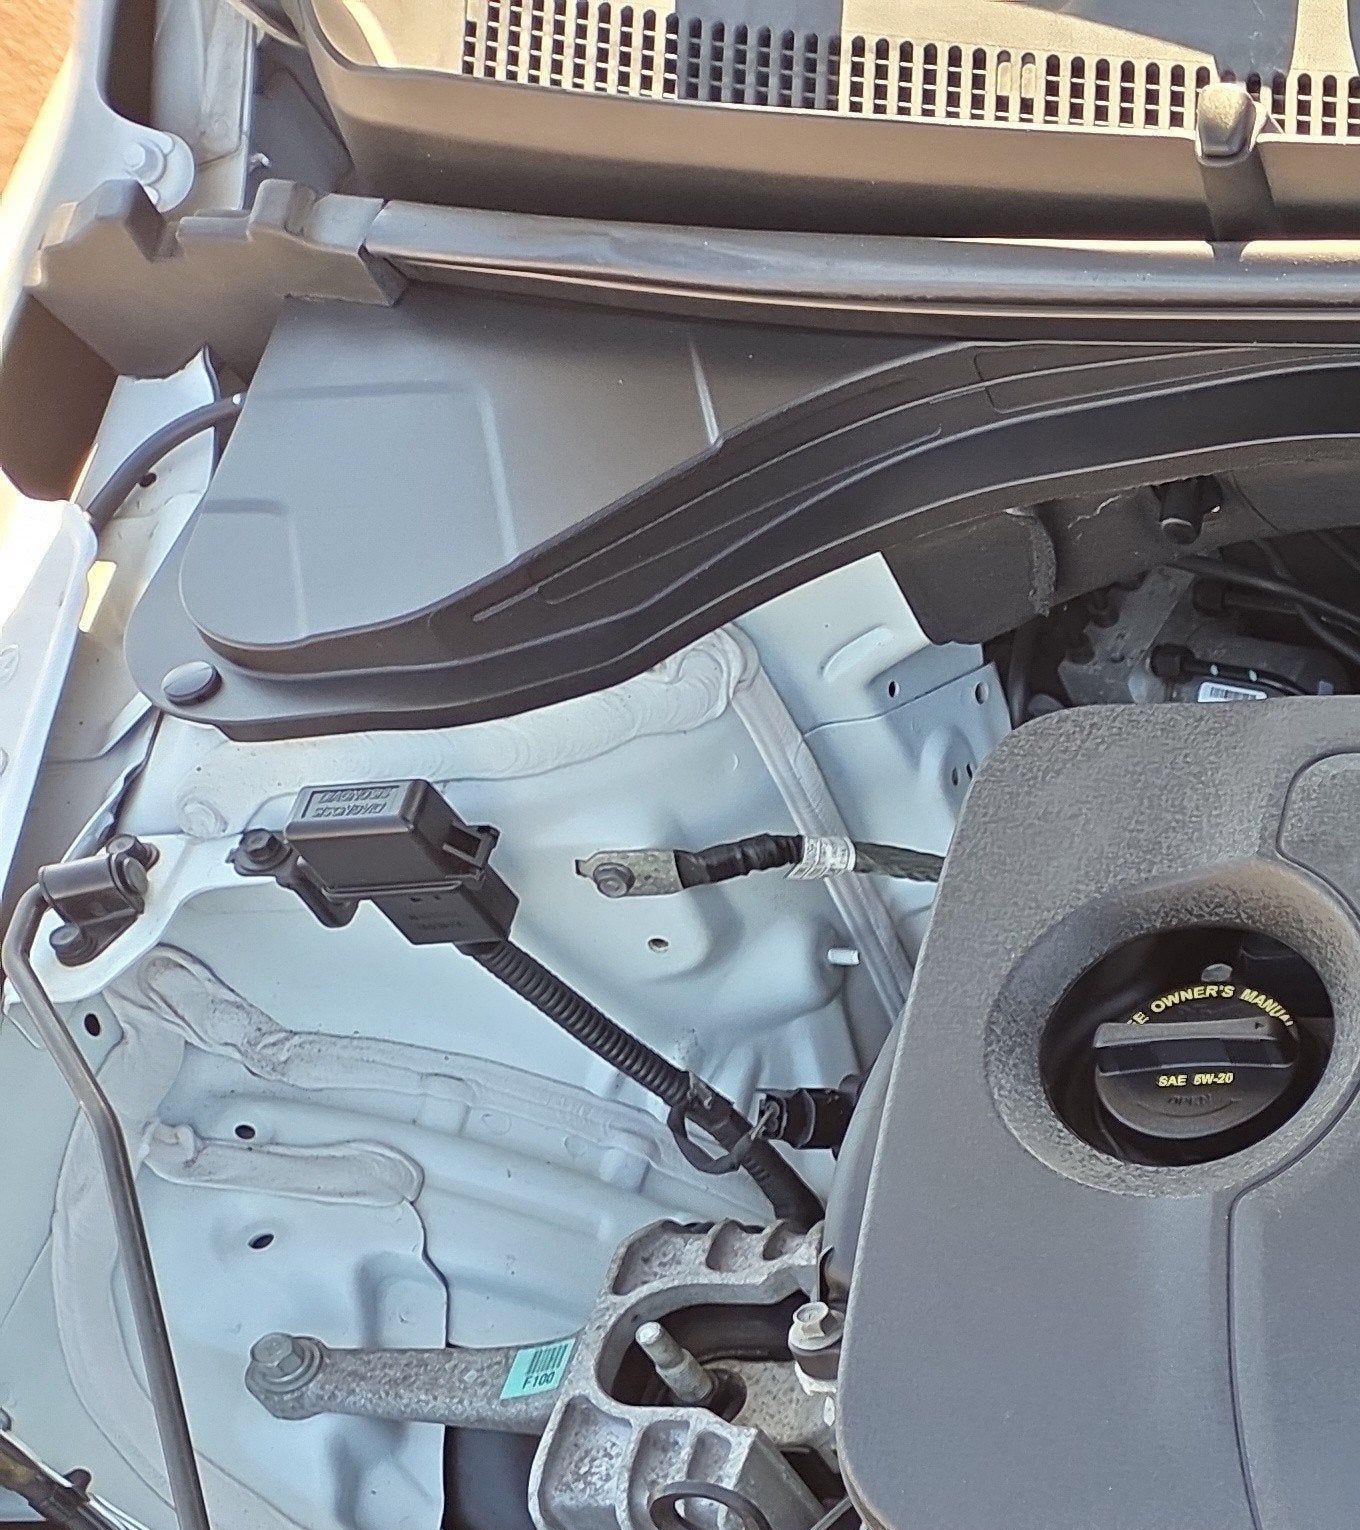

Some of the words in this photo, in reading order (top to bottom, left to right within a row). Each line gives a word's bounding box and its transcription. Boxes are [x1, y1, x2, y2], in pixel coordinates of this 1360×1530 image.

[1150, 985, 1236, 1013] OWNER'S
[1157, 1074, 1187, 1087] SAE
[1193, 1072, 1234, 1086] 5W-20
[522, 1372, 556, 1390] F100
